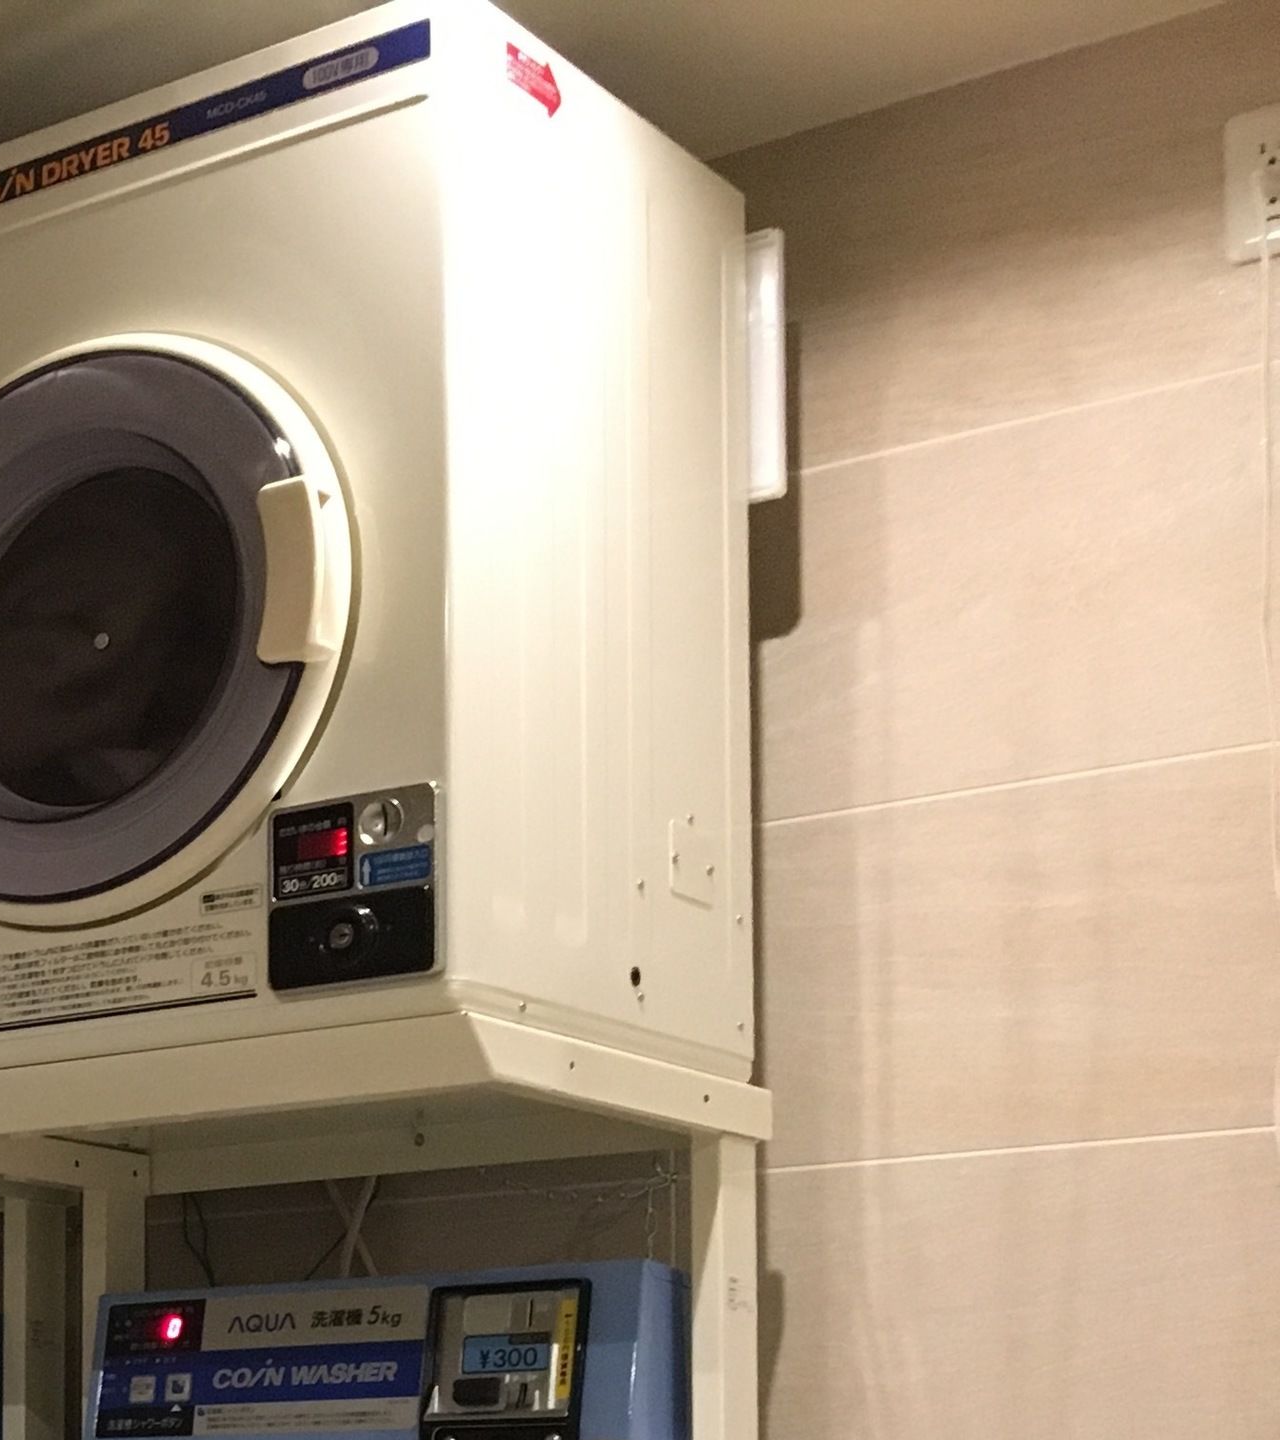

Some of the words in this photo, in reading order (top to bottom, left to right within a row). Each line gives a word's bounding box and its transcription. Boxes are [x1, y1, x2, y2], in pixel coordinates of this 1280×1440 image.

[40, 135, 130, 189] DRYER
[137, 121, 172, 151] 45
[228, 1312, 297, 1334] AQUA
[310, 1309, 362, 1329] 洗濯機
[366, 1305, 403, 1328] 5kg
[478, 1346, 539, 1369] ¥300
[291, 1361, 399, 1385] WASHER
